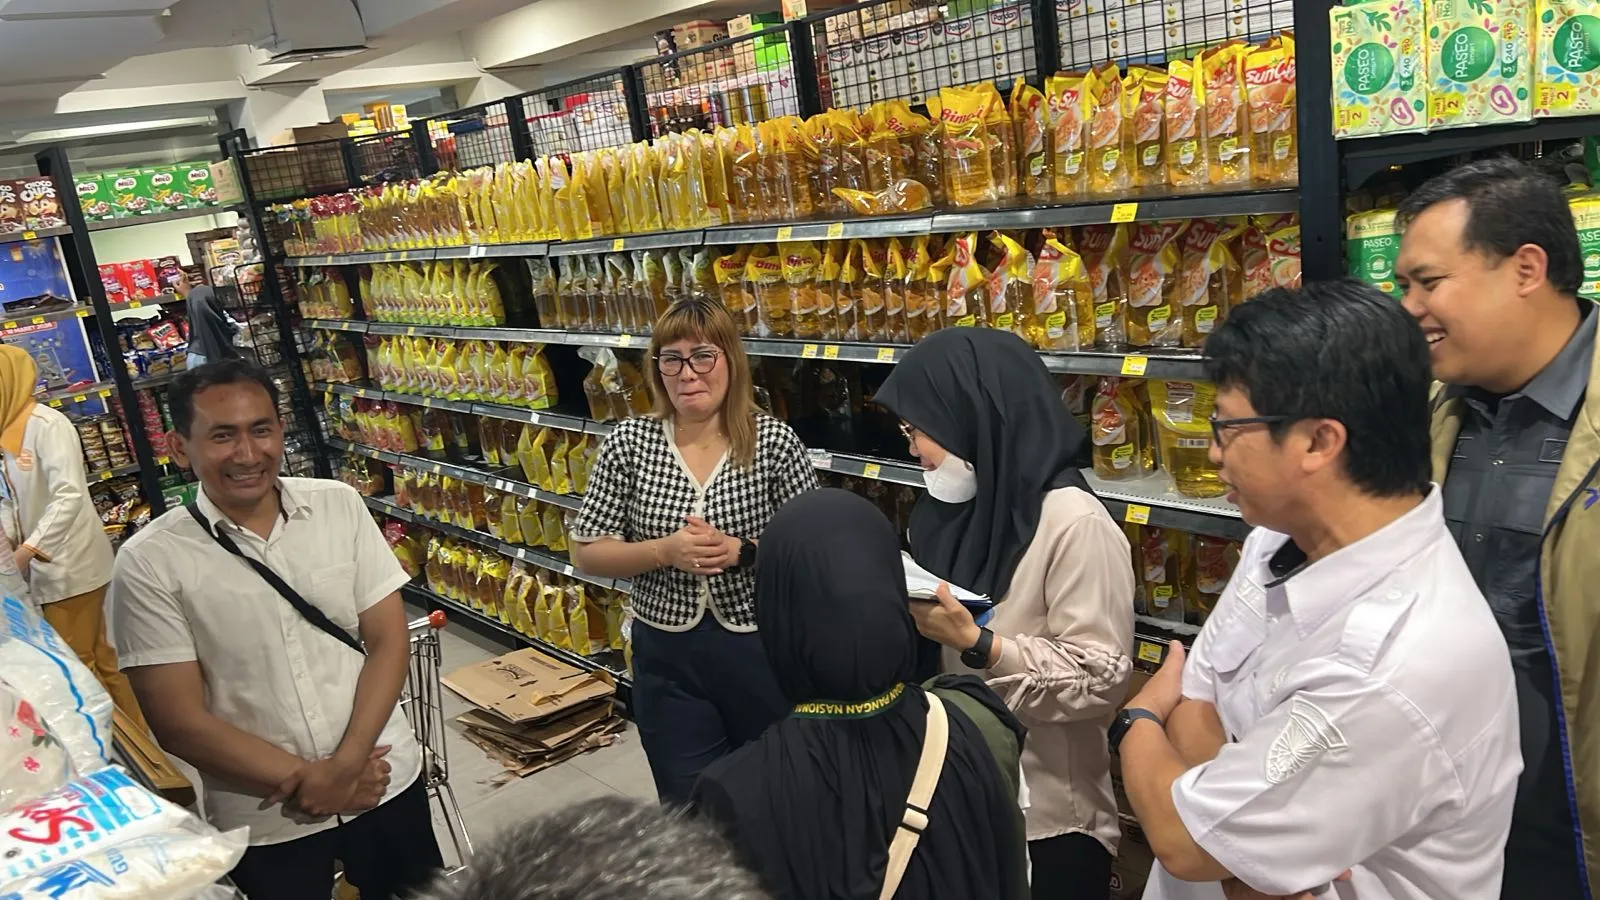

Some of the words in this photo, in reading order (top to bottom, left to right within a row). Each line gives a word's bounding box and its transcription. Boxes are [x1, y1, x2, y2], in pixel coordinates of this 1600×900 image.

[1567, 21, 1583, 67] PASEO
[1454, 33, 1468, 78] PASEO
[1506, 42, 1514, 61] 240
[1358, 49, 1369, 91] PASEO
[1557, 90, 1569, 100] 2
[1448, 100, 1459, 109] 2
[1352, 111, 1362, 120] 2
[154, 175, 171, 184] MILO
[190, 171, 206, 179] MILO
[117, 180, 135, 188] MILO
[1577, 230, 1600, 242] ASE
[1363, 237, 1393, 249] PASEO
[845, 696, 891, 714] PANGAN
